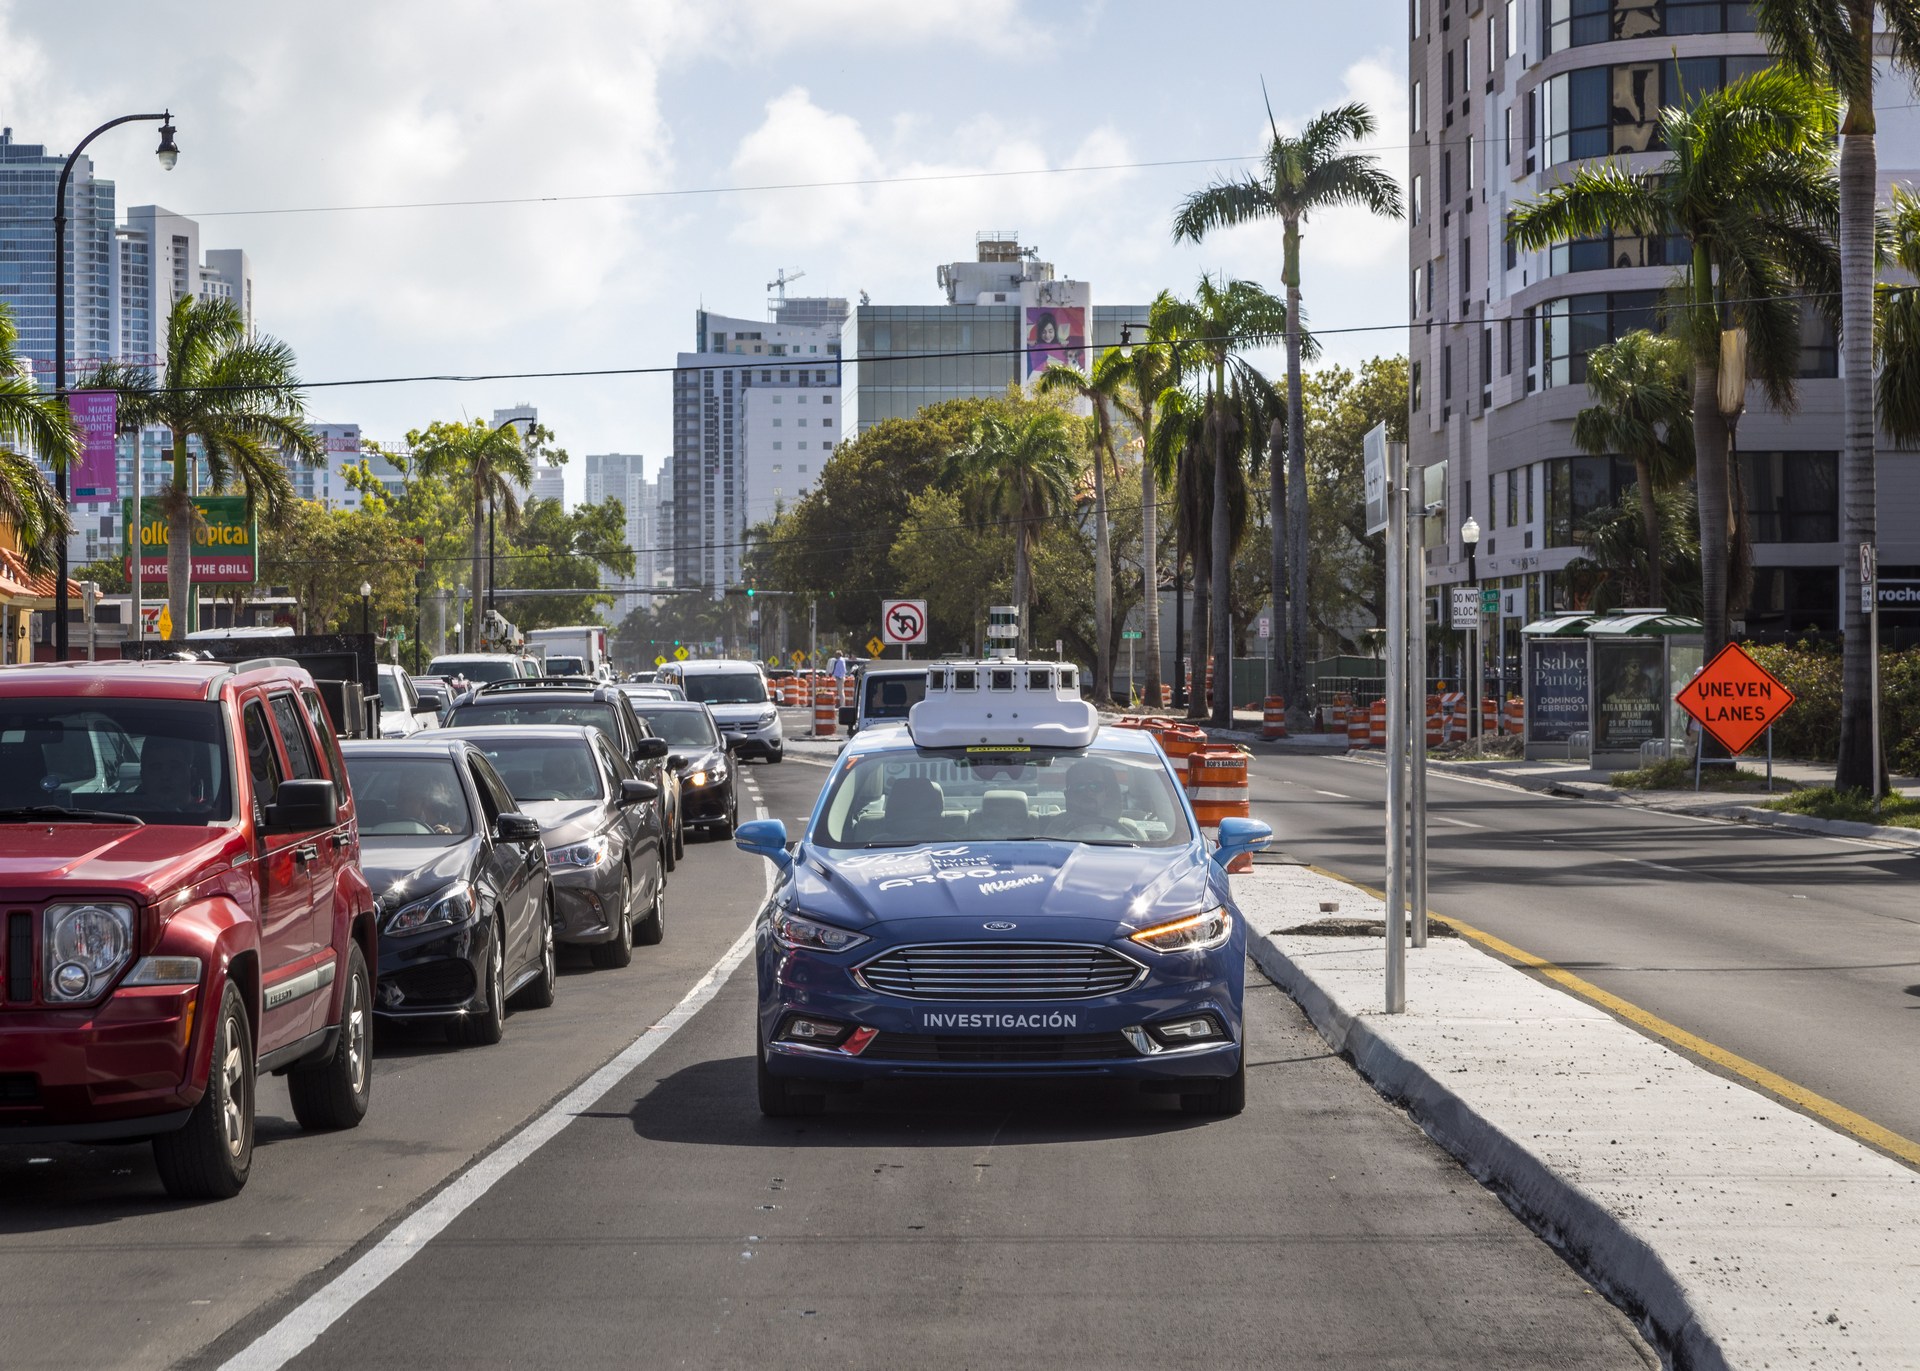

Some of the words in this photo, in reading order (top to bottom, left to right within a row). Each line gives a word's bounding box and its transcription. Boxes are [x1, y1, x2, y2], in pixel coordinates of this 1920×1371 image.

[88, 405, 112, 413] MIAMI
[73, 414, 112, 423] ROMANCE
[129, 564, 168, 575] ICKE
[196, 564, 216, 574] THE
[219, 564, 248, 574] GRILL
[1453, 593, 1464, 603] DO
[1453, 606, 1478, 616] BLOCK
[1535, 651, 1585, 670] Isabe
[1698, 682, 1771, 698] UNEVEN
[1537, 704, 1579, 712] FEBRERO
[1602, 703, 1631, 711] RICARDO
[1633, 703, 1660, 711] ARJONA
[1706, 706, 1765, 721] LANES
[978, 874, 1045, 896] Miami
[923, 1011, 1077, 1028] INVESTIGACIÓN
